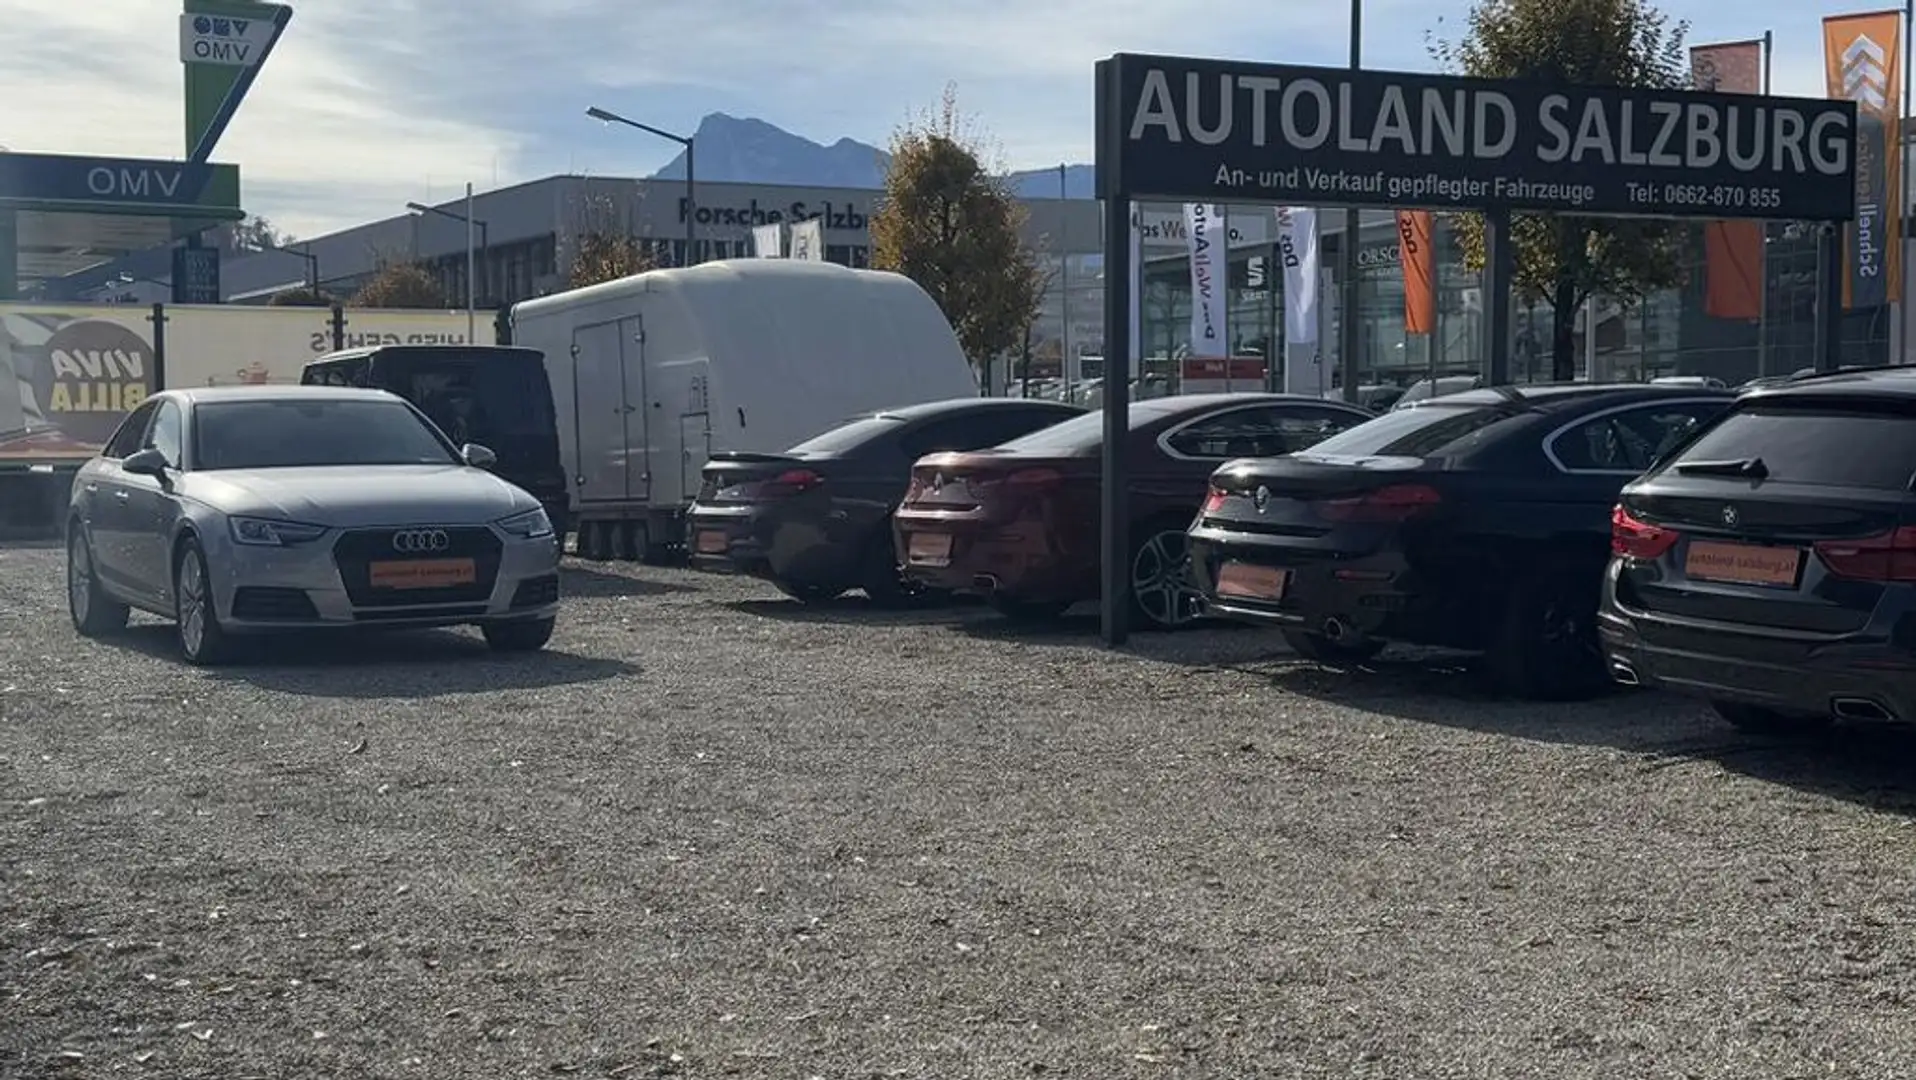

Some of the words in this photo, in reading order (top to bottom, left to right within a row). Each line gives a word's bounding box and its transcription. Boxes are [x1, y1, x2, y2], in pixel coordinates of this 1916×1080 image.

[194, 41, 249, 61] OMV
[1129, 69, 1517, 159] AUTOLAND
[1537, 94, 1848, 175] SALZBURG
[88, 167, 182, 197] OMV
[1215, 164, 1253, 187] An-
[1259, 167, 1299, 189] und
[1304, 169, 1385, 193] Verkauf
[1388, 174, 1489, 200] gepflegter
[1494, 178, 1595, 201] Fahrzeuge
[1626, 182, 1659, 203] Tel:
[1749, 188, 1782, 207] 855
[791, 201, 869, 229] Slzb
